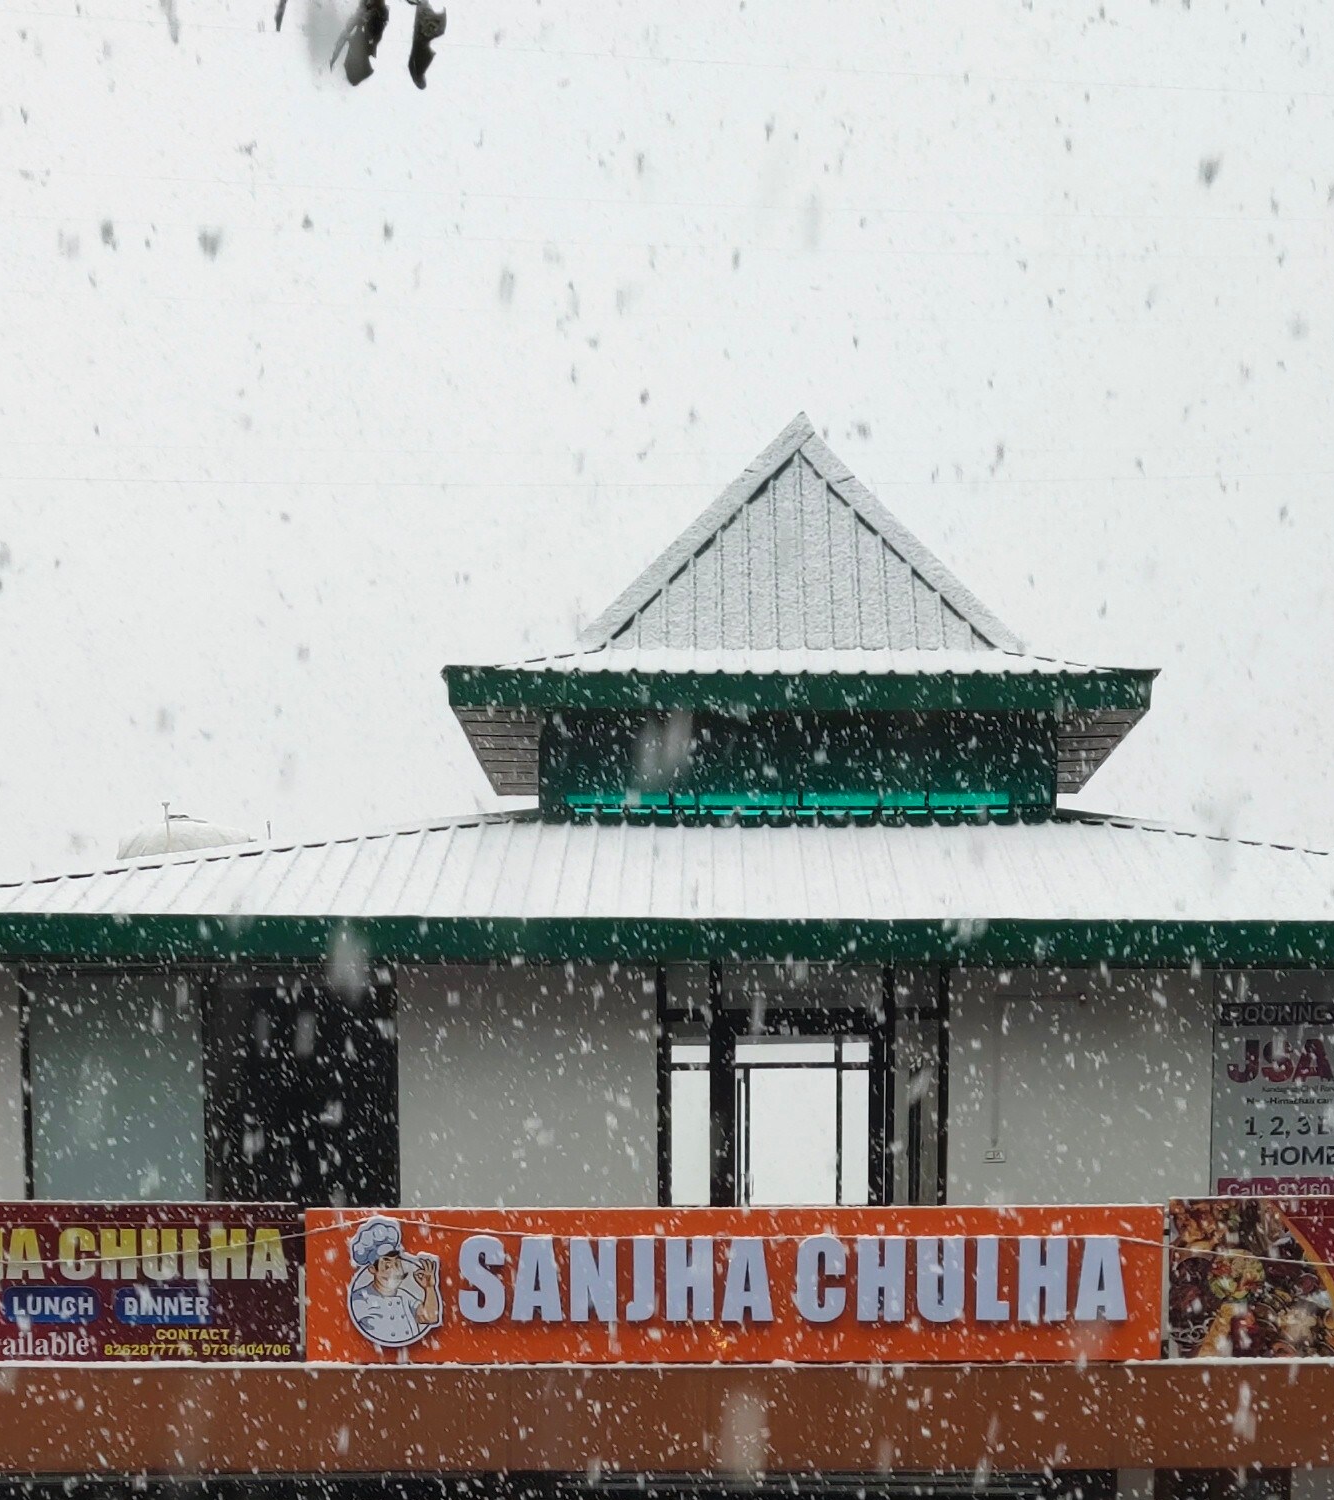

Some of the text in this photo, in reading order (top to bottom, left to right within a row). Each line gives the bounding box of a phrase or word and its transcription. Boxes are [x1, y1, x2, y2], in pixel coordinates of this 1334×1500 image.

[1227, 1038, 1334, 1083] JSA
[1244, 1116, 1264, 1139] 1,
[1269, 1116, 1291, 1139] 2,
[1296, 1116, 1312, 1135] 3
[58, 1227, 289, 1281] CHULHA
[458, 1235, 1129, 1322] SANJHA CHULHA
[12, 1296, 94, 1316] LUNCH
[123, 1296, 210, 1316] DINNER
[155, 1328, 230, 1340] CONTACT
